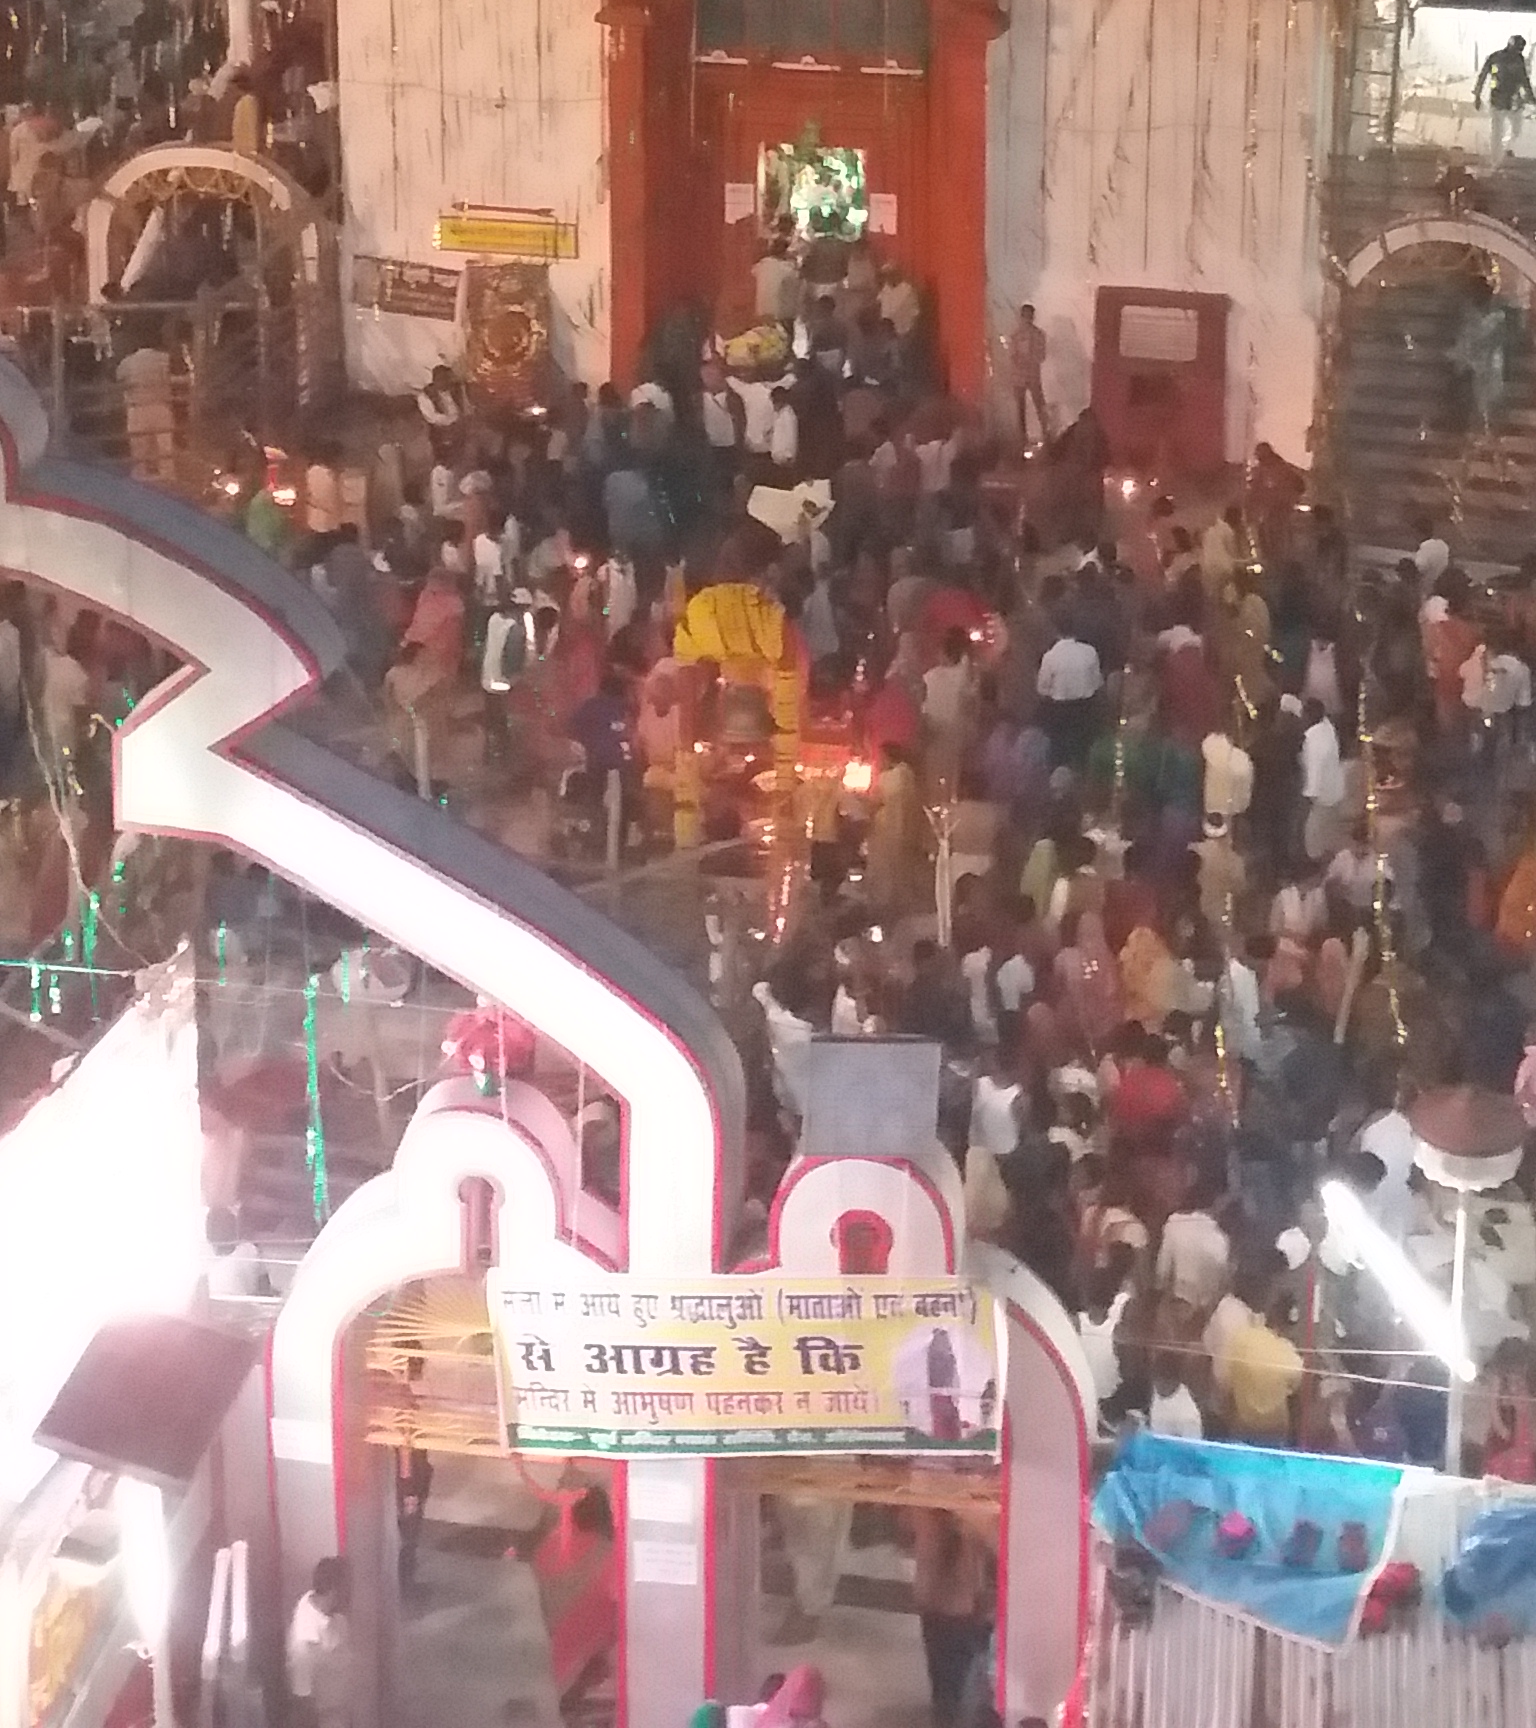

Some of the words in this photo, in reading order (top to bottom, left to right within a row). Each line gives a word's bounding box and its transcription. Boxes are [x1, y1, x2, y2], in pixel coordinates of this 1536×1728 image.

[516, 1333, 556, 1372] से
[583, 1341, 717, 1376] आग्रह
[731, 1335, 772, 1376] है
[794, 1335, 864, 1375] कि
[793, 1391, 811, 1414] न
